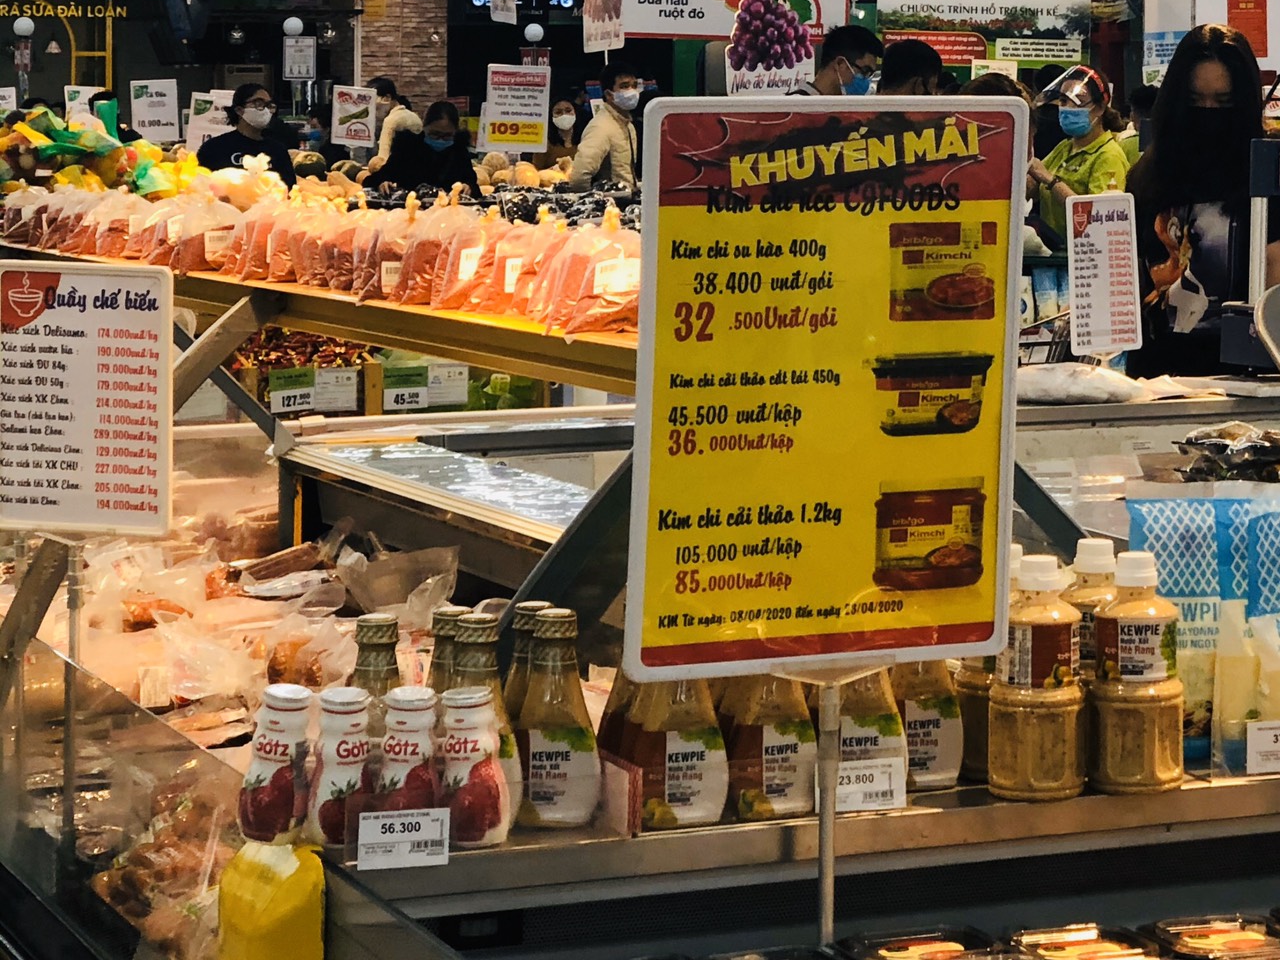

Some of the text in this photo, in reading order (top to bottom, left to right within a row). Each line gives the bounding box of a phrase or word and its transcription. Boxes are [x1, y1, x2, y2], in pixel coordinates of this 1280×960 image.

[659, 6, 705, 20] ruột đỏ
[900, 3, 944, 14] CHƯƠNG
[948, 3, 978, 15] TRÌNH
[490, 122, 519, 135] 109
[730, 117, 979, 188] KHUYẾN MÃI
[670, 238, 828, 261] Kim chi su hào 400g
[693, 270, 834, 297] 38.400 vnđ/gói
[44, 286, 160, 313] Quầy chế biến
[674, 301, 716, 343] 32
[669, 372, 695, 390] Kim
[698, 372, 716, 389] chi
[718, 371, 737, 388] cải
[740, 370, 766, 388] thảo
[812, 368, 841, 386] 450g
[281, 394, 298, 408] 127
[393, 393, 406, 406] 45
[668, 402, 802, 429] 45.500 vnđ/hộp
[658, 502, 843, 531] Kim chi cải thảo 1.2kg
[675, 537, 803, 566] 105.000 vnđ/hộp
[1120, 624, 1161, 636] KEWPIE
[907, 718, 941, 730] KEWPIE
[384, 735, 420, 757] Götz
[444, 734, 481, 755] Götz
[841, 736, 880, 748] KEWPIE
[531, 751, 571, 763] KEWPIE
[667, 751, 706, 763] KEWPIE
[764, 744, 799, 756] KEWPIE
[380, 821, 421, 835] 56.300
